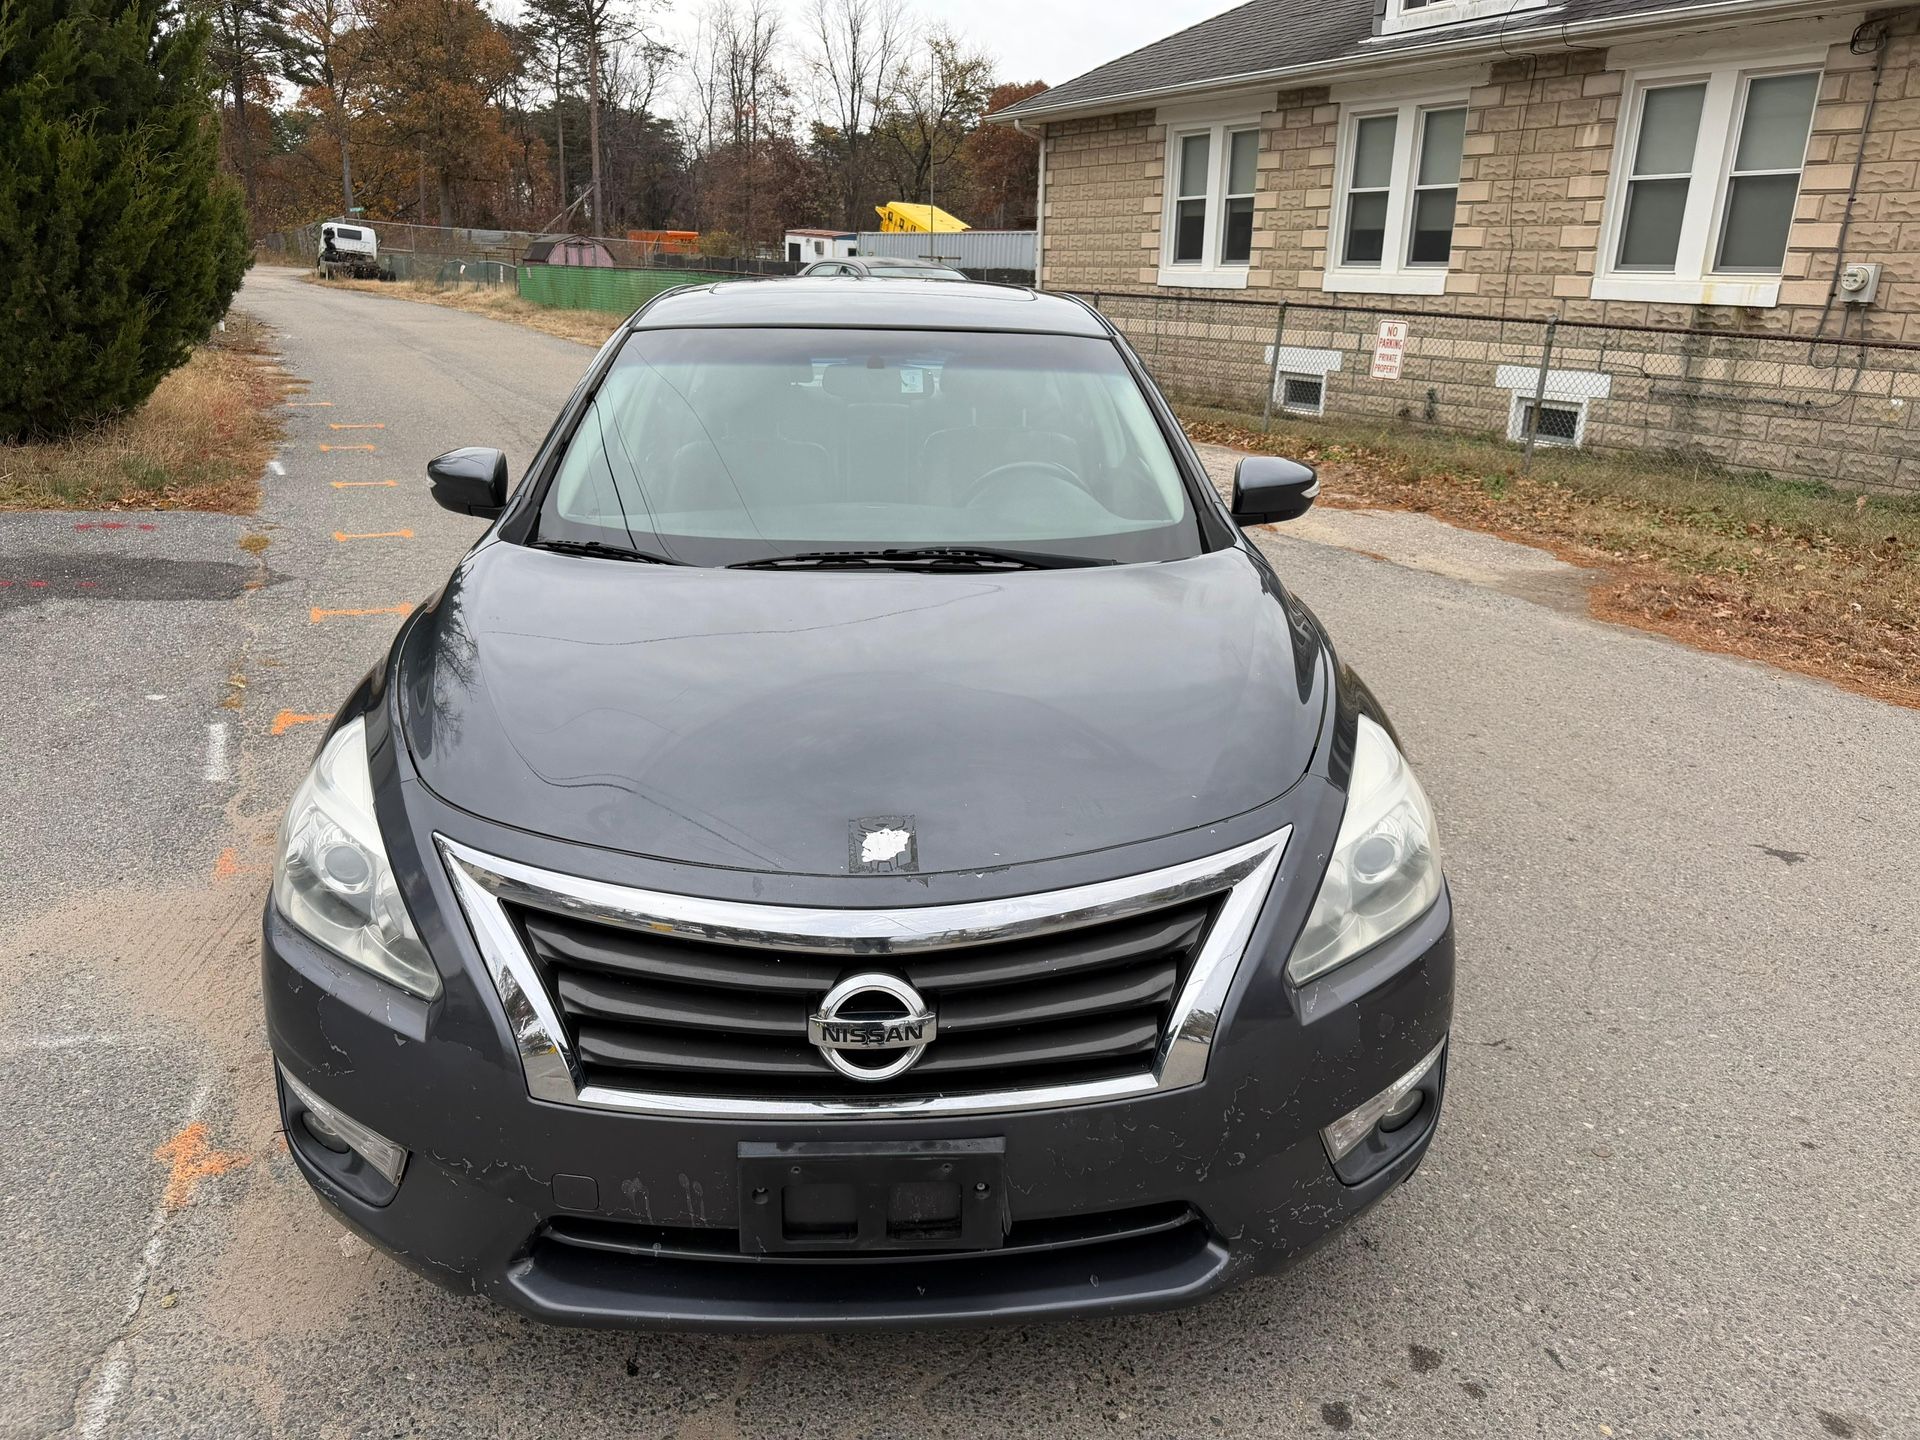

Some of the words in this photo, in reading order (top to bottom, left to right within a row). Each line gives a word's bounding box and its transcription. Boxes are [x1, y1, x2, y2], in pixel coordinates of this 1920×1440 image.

[1387, 326, 1398, 337] NO
[1379, 338, 1402, 349] PARKING
[1379, 353, 1397, 362] PRIVATE
[1375, 364, 1398, 373] PROPERTY
[822, 1024, 923, 1043] NISSAN
